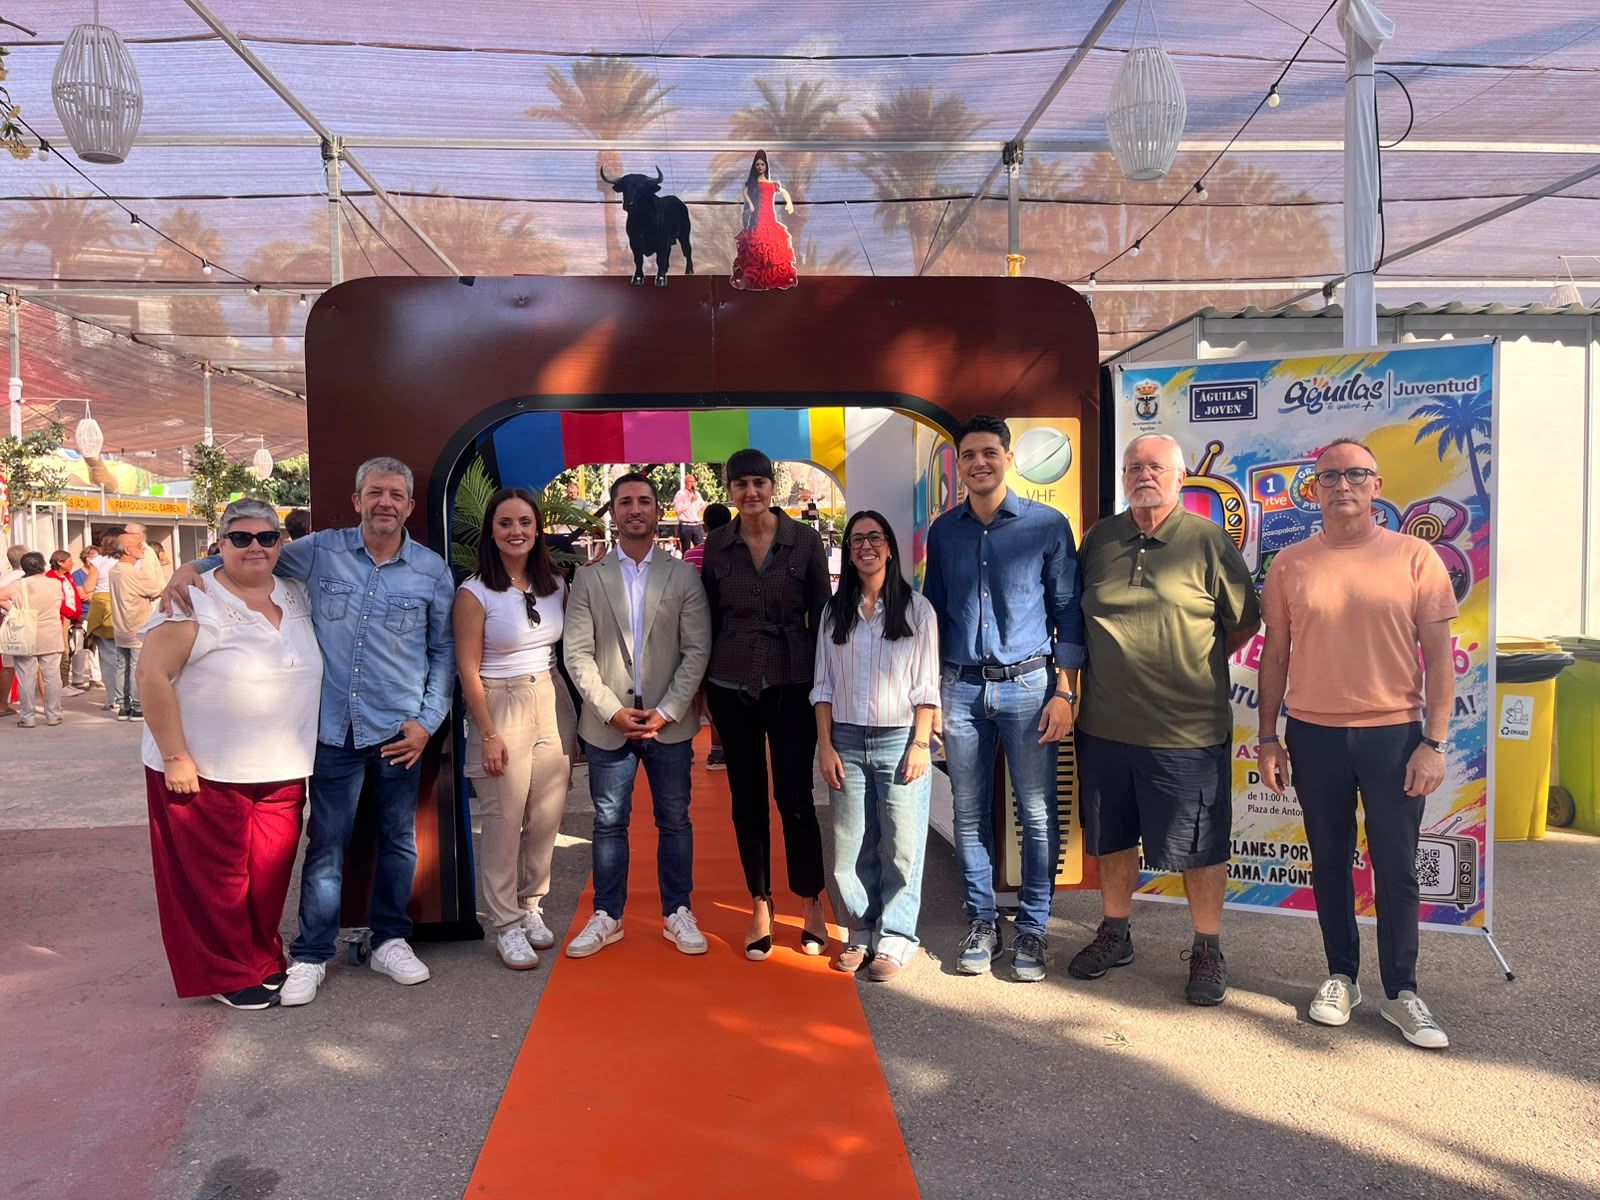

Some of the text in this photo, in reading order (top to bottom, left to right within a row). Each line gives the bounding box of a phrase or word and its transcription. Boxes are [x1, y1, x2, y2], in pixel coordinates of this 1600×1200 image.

[1394, 378, 1478, 396] Juventud
[1199, 390, 1248, 403] ÁGUILAS
[1204, 404, 1242, 416] JOVEN
[1266, 477, 1276, 493] 1
[1026, 489, 1056, 503] VHF
[1265, 496, 1288, 506] rtve
[1262, 525, 1305, 538] pasapalabra
[1247, 792, 1258, 801] de
[1247, 804, 1268, 814] Plaza
[1270, 806, 1280, 815] de
[1280, 843, 1309, 861] POR
[1226, 863, 1265, 883] RAMA,
